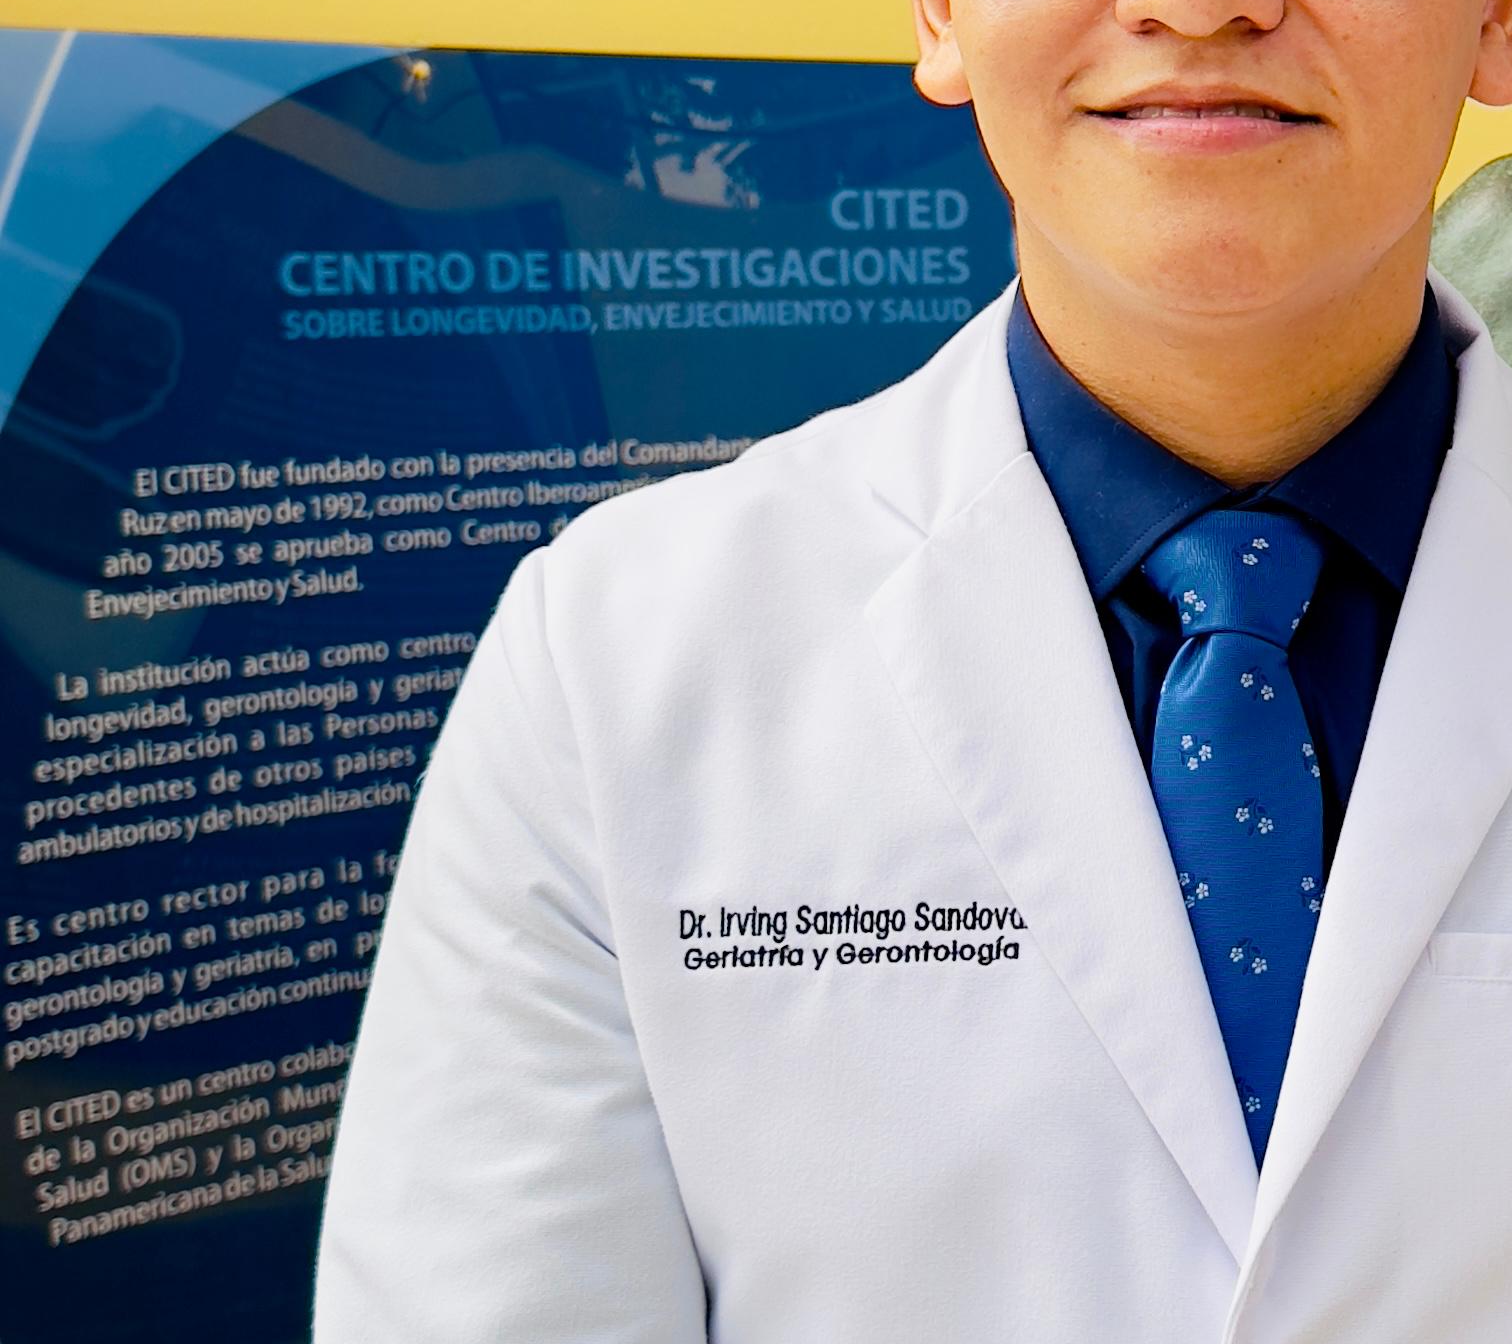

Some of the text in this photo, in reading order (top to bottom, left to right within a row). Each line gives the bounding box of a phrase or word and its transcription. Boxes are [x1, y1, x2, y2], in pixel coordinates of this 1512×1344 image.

[831, 189, 968, 230] CITED
[279, 246, 970, 296] CENTRO DE INVESTIGACIONES
[284, 298, 972, 340] SOBRE LONGEVIDAD, ENVEJECIMIENTO Y SALUD
[134, 468, 157, 497] El
[163, 463, 235, 494] CITED
[240, 460, 278, 488] fue
[284, 454, 385, 487] fundado
[391, 456, 434, 480] con
[439, 448, 460, 476] la
[467, 446, 576, 479] presencia
[582, 440, 617, 467] del
[103, 548, 151, 578] año
[162, 540, 223, 572] 2005
[235, 541, 263, 566] se
[273, 528, 374, 566] aprueba
[383, 525, 451, 553] como
[461, 517, 540, 546] Centro
[120, 508, 168, 537] Ruz
[169, 509, 200, 534] en
[205, 503, 272, 533] mayo
[276, 497, 306, 524] de
[311, 491, 374, 521] 1992,
[376, 490, 443, 518] como
[445, 484, 523, 511] Centro
[85, 564, 365, 621] Envejecimiento y Salud.
[57, 632, 476, 702] La institución actúa como centro
[34, 706, 439, 784] especialización a las Personas
[45, 698, 193, 743] longevidad,
[204, 676, 358, 726] gerontología
[369, 674, 385, 704] y
[16, 777, 411, 865] ambulatorios y de hospitalización
[25, 743, 417, 830] procedentes de otros países
[4, 889, 391, 986] capacitación en temas de lo
[7, 913, 39, 946] Es
[52, 897, 149, 937] centro
[161, 878, 250, 916] rector
[262, 865, 325, 904] para
[336, 855, 363, 885] la
[680, 901, 1029, 944] Dr. Irving Santiago Sandova
[3, 971, 165, 1032] gerontología
[171, 967, 187, 996] y
[195, 941, 300, 991] geriatría,
[305, 936, 338, 963] en
[684, 935, 1021, 971] Geriatría y Gerontología
[4, 1016, 135, 1072] postgrado
[135, 1013, 153, 1041] y
[153, 984, 276, 1030] educación
[16, 1106, 41, 1140] El
[46, 1089, 121, 1132] CITED
[125, 1086, 155, 1114] es
[159, 1077, 193, 1104] un
[197, 1059, 275, 1097] centro
[25, 1144, 61, 1176] de
[70, 1134, 96, 1165] la
[104, 1095, 270, 1155] Organización
[36, 1168, 110, 1212] Salud
[119, 1145, 197, 1193] (OMS)
[206, 1144, 224, 1176] y
[231, 1133, 256, 1161] la
[48, 1181, 222, 1248] Panamericana
[223, 1171, 256, 1202] de
[256, 1163, 279, 1192] la
